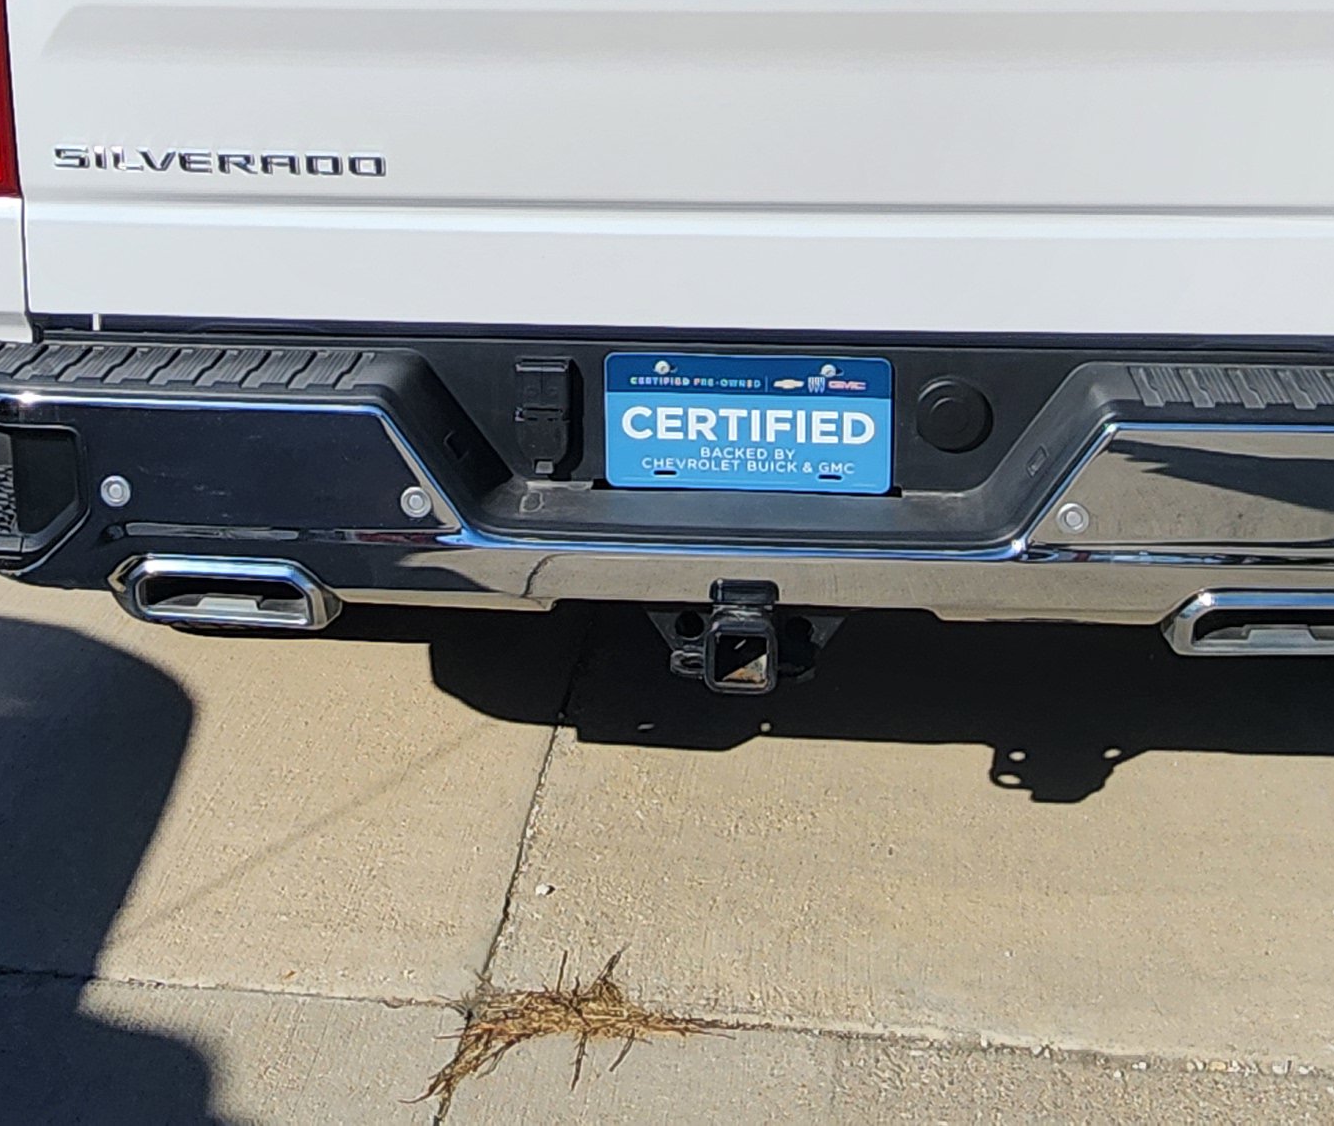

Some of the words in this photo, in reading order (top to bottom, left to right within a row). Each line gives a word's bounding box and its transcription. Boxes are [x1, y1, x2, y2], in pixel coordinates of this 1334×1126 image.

[53, 145, 387, 178] SILVERADO
[630, 376, 690, 386] CERTIFIED
[827, 380, 867, 391] GMC
[621, 405, 876, 445] CERTIFIED
[700, 446, 768, 460] BACKED
[774, 448, 796, 461] BY
[641, 456, 741, 472] CHEVROLET
[747, 460, 797, 473] BUICK
[802, 461, 813, 473] &
[818, 462, 855, 474] GMC
